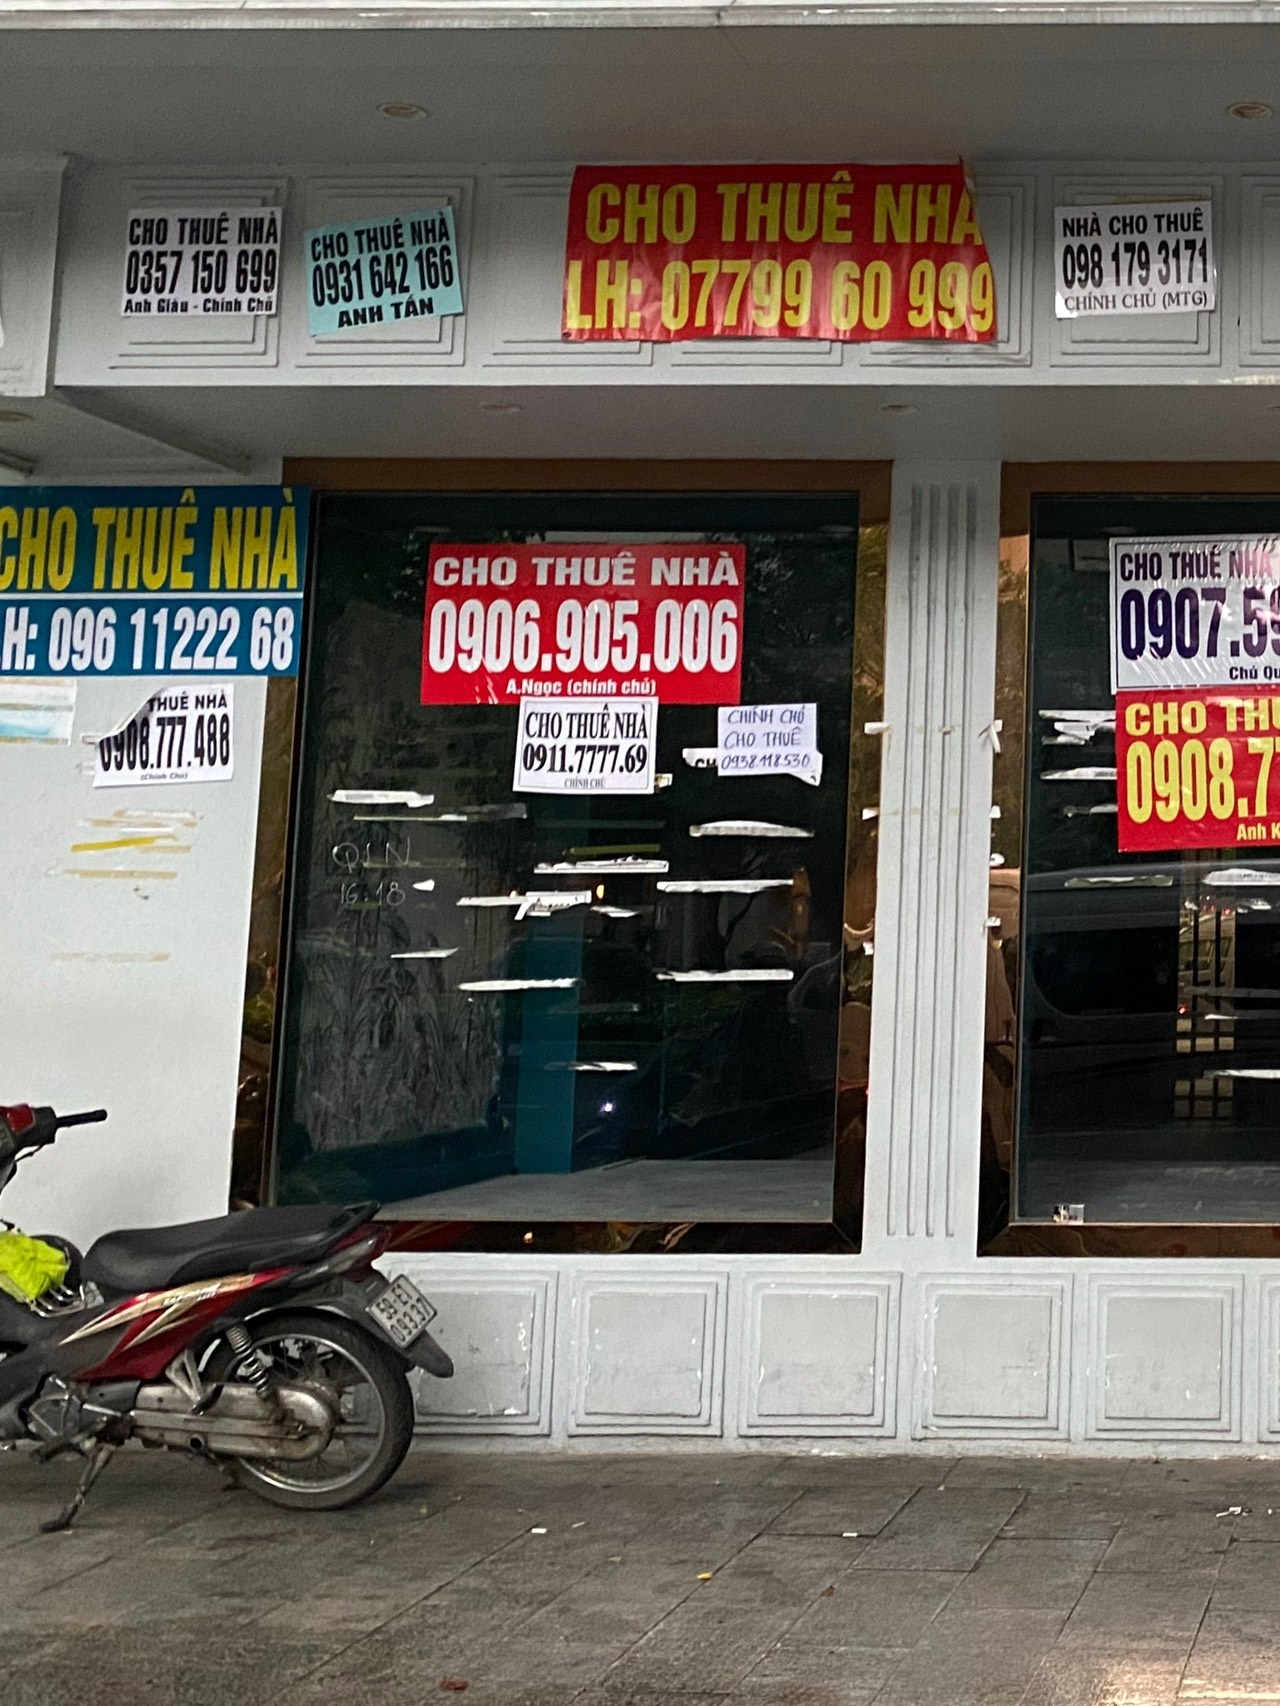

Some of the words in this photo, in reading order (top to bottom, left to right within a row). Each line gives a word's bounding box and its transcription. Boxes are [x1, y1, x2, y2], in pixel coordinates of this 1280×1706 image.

[585, 183, 696, 245] CHO
[717, 170, 856, 245] THUÊ
[1063, 212, 1102, 237] NHÀ
[1109, 215, 1148, 235] CHO
[1153, 207, 1203, 233] THUÊ
[129, 218, 168, 245] CHO
[178, 212, 230, 245] THUÊ
[238, 211, 278, 244] NHÀ
[311, 232, 348, 262] CHO
[354, 217, 405, 255] THUÊ
[410, 211, 450, 246] NHÀ
[126, 250, 183, 294] 0357
[191, 250, 228, 294] 150
[235, 249, 277, 294] 699
[313, 258, 364, 307] 0931
[369, 251, 410, 298] 642
[414, 244, 454, 291] 166
[1063, 243, 1104, 289] 098
[1111, 241, 1150, 286] 179
[1157, 237, 1208, 285] 3171
[124, 299, 151, 313] Anh
[203, 297, 241, 312] Chính
[567, 259, 642, 330] LH:
[660, 258, 813, 331] 07799
[831, 260, 892, 331] 60
[907, 259, 994, 333] 999
[1064, 291, 1117, 311] CHÍNH
[1122, 288, 1156, 309] CHỦ
[1162, 290, 1208, 310] (MTG)
[338, 305, 383, 328] ANH
[0, 506, 77, 591] CHO
[92, 488, 198, 590] THUÊ
[209, 488, 298, 590] NHÀ
[433, 556, 517, 587] CHO
[532, 551, 637, 586] THUÊ
[651, 551, 739, 586] NHÀ
[1120, 552, 1163, 581] CHO
[1169, 545, 1222, 580] THUÊ
[0, 607, 38, 671] H:
[49, 606, 117, 671] 096
[130, 606, 240, 670] 11222
[250, 606, 294, 671] 68
[428, 599, 738, 674] 0906.905.006
[149, 691, 189, 712] THUÊ
[195, 689, 228, 710] NHÀ
[567, 679, 617, 696] (chính
[526, 712, 562, 738] CHO
[566, 703, 610, 738] THUÊ
[613, 704, 648, 738] NHÀ
[727, 706, 773, 724] CHÍNH
[1125, 701, 1207, 736] CHO
[100, 713, 230, 772] 0908.777.488
[724, 731, 756, 750] CHO
[763, 726, 802, 747] THUÊ
[523, 743, 647, 773] 0911.7777.69
[1237, 824, 1267, 841] Anh
